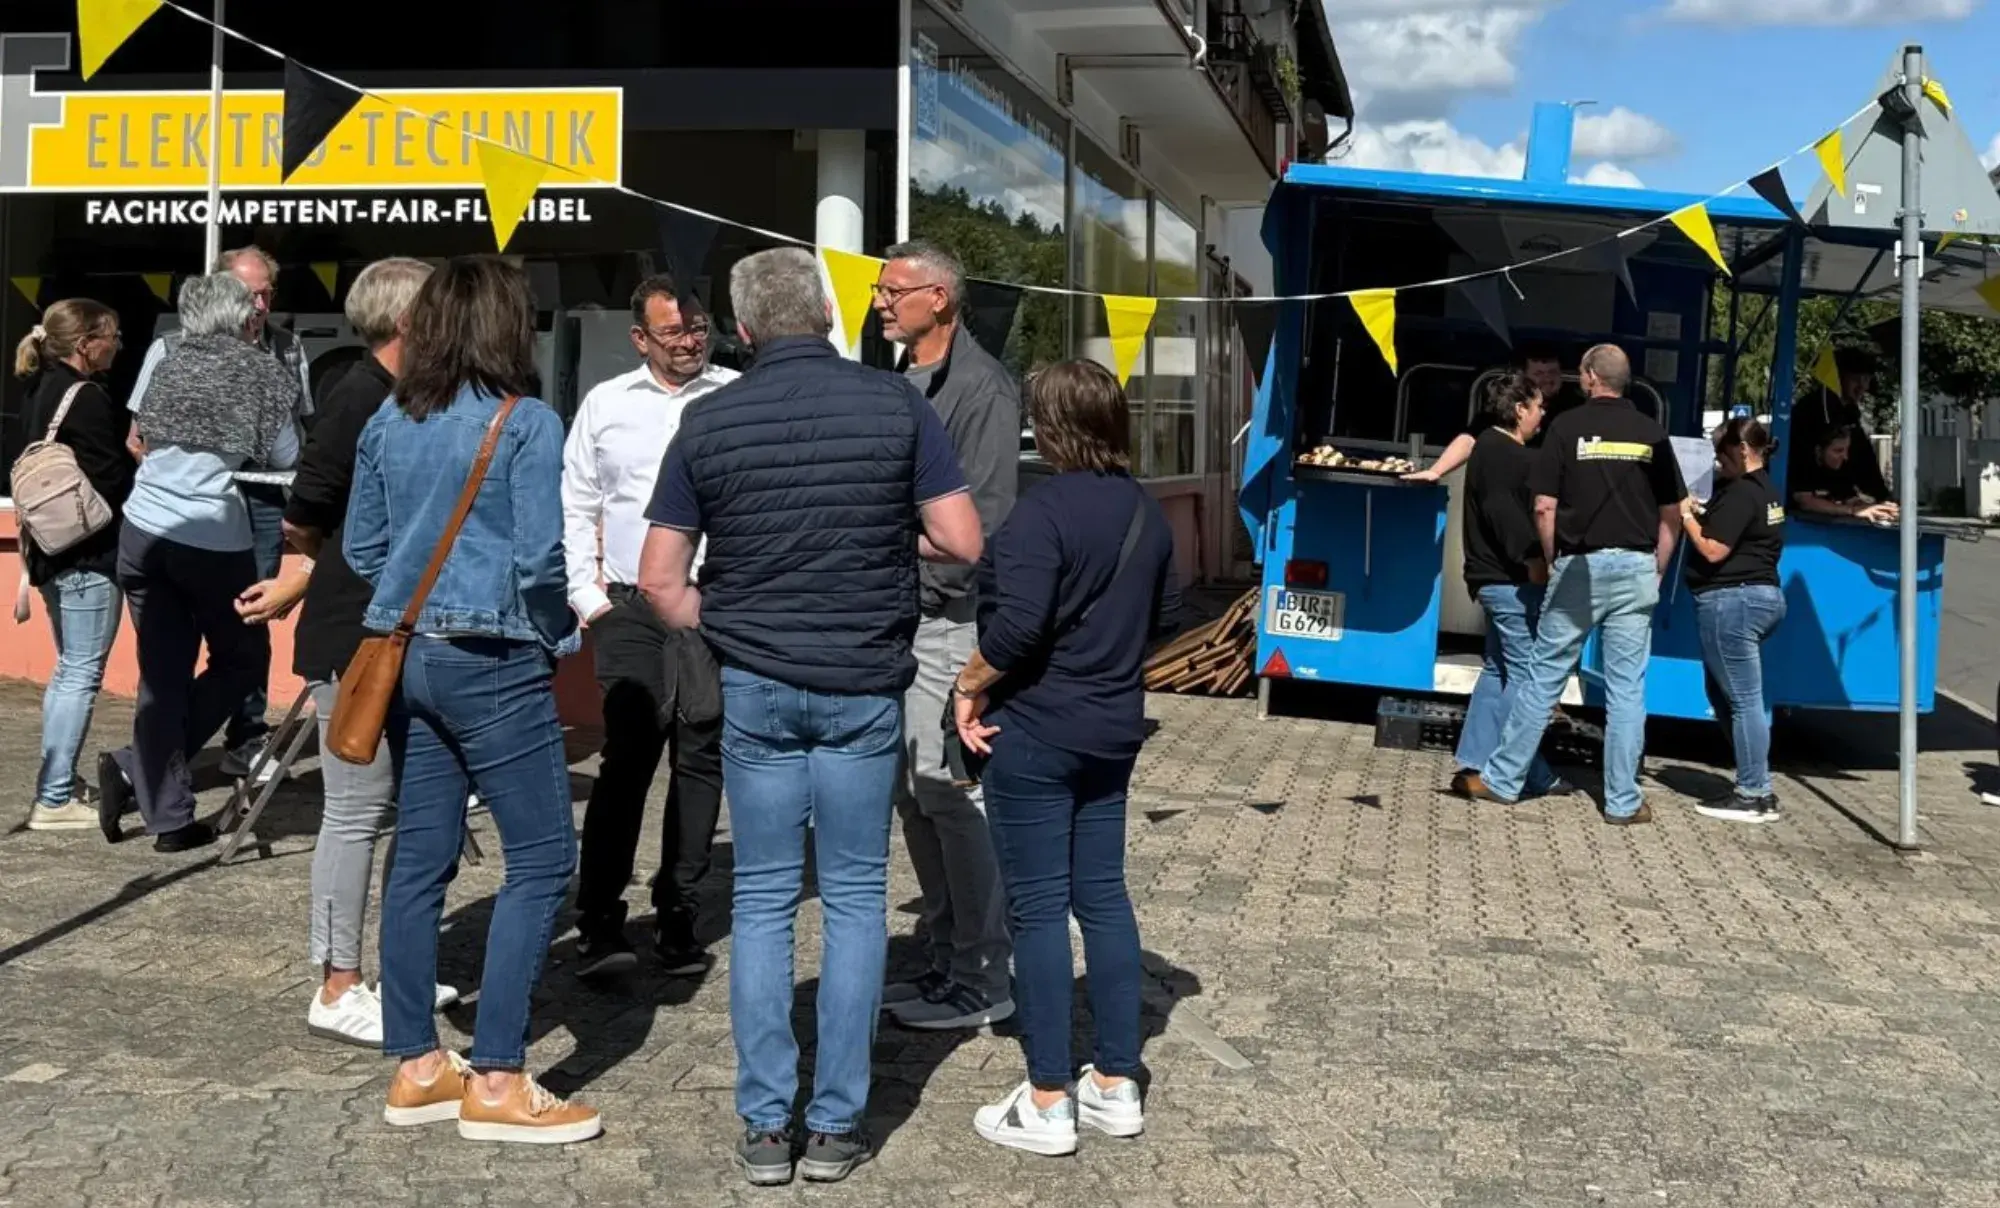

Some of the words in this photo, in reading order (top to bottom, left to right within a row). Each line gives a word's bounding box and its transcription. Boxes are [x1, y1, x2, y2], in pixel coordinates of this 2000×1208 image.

[86, 199, 592, 225] FACHKOMPETENT-FAIR-FLIBEL
[1287, 594, 1320, 613] BIR
[1280, 613, 1291, 630] G
[1294, 614, 1328, 632] 679
